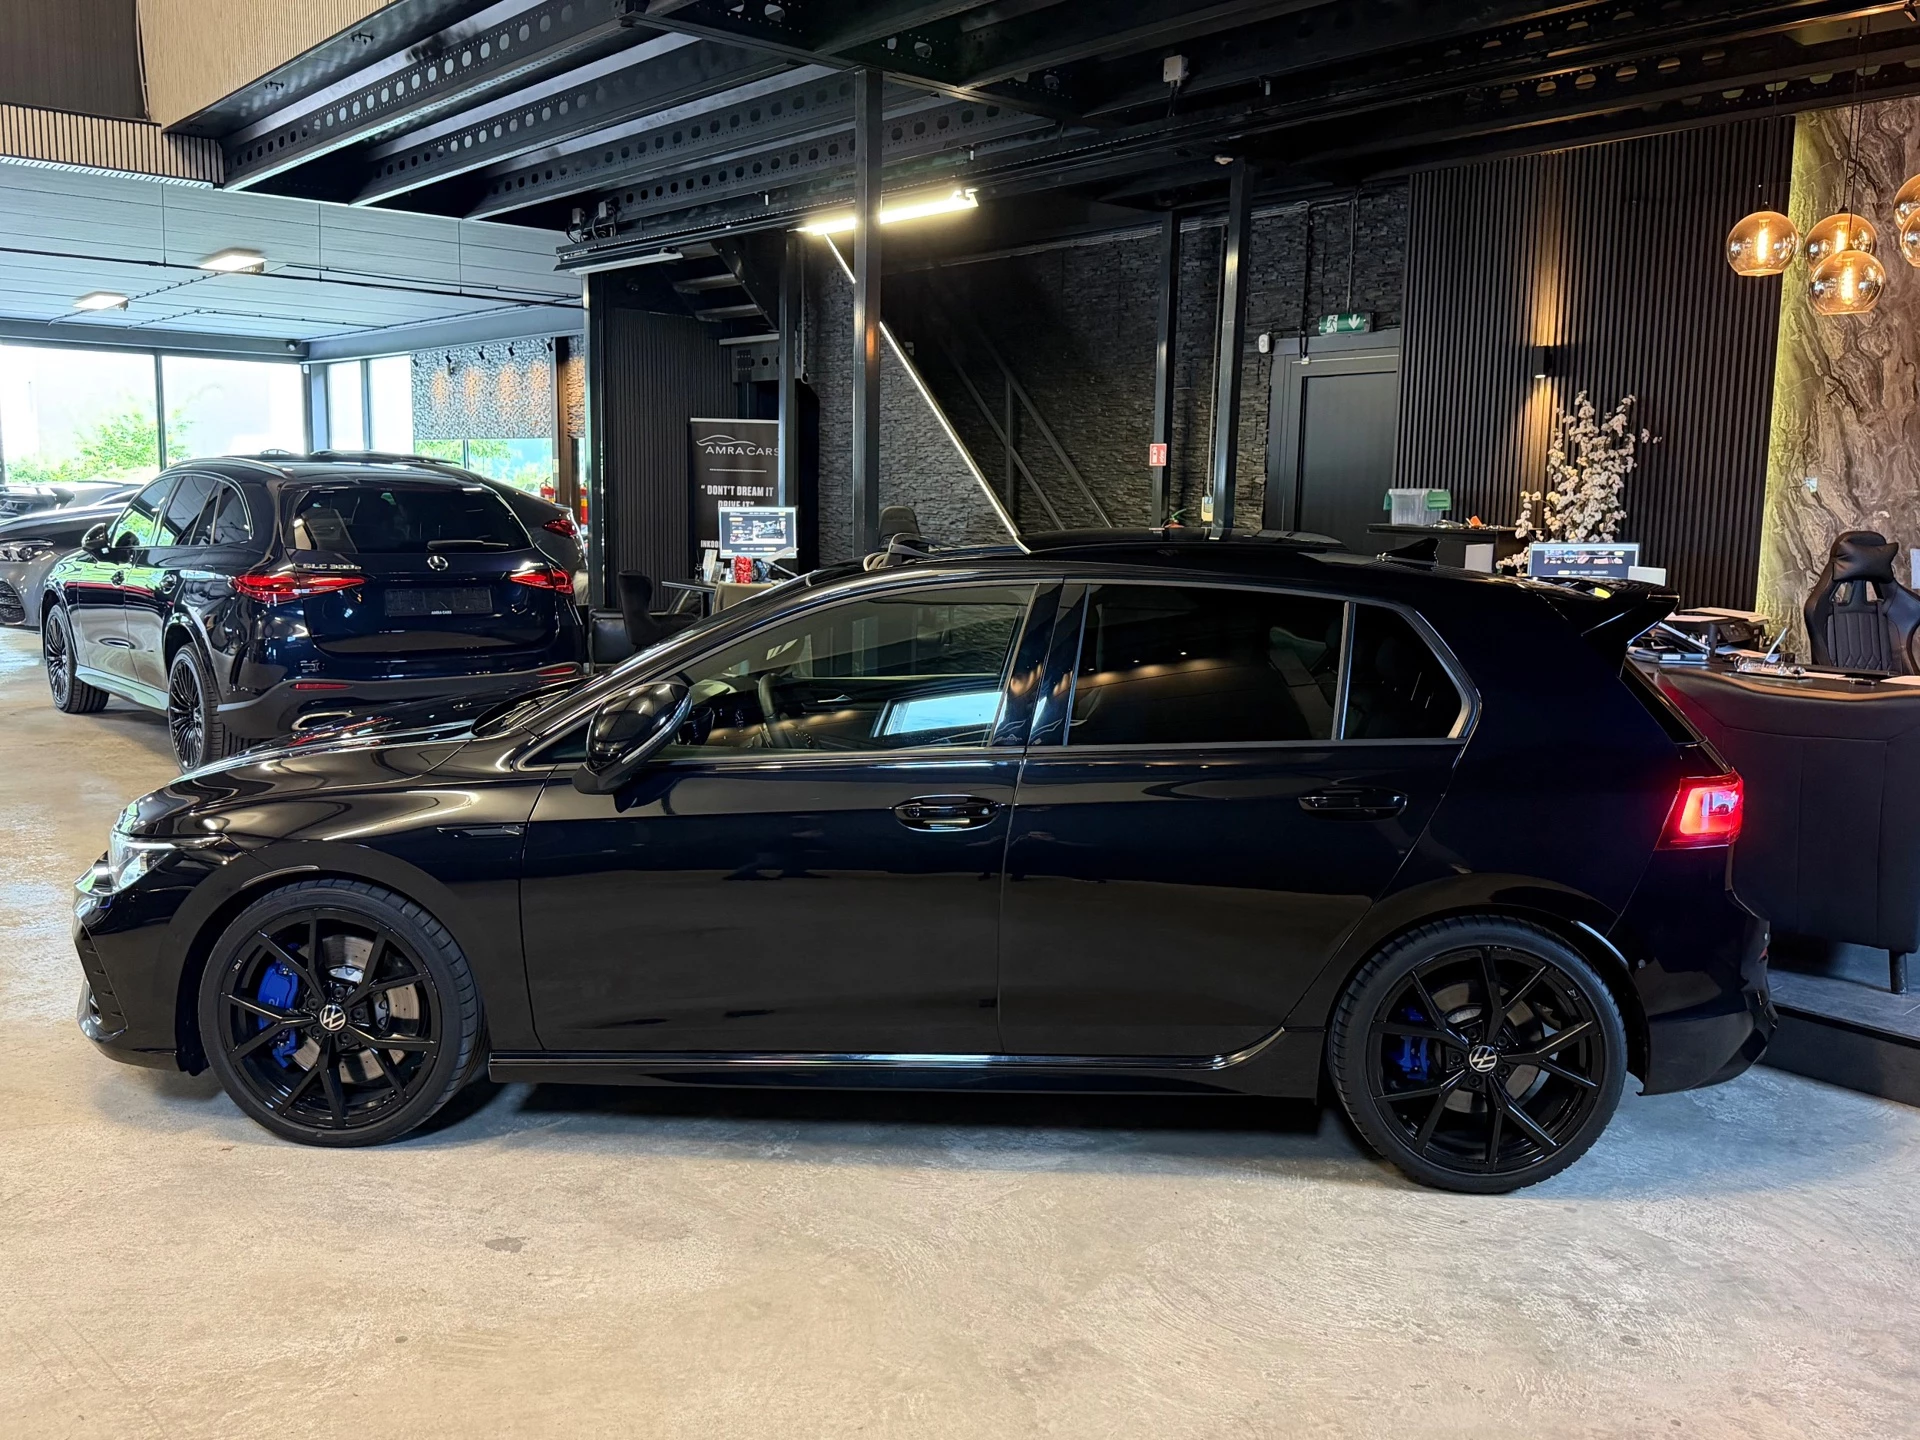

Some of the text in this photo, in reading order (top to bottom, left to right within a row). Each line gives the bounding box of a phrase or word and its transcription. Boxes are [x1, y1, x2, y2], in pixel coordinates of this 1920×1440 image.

[705, 446, 779, 456] AMRA CARS
[736, 486, 764, 497] DREAM
[765, 487, 774, 497] IT
[700, 540, 719, 548] INKOO
